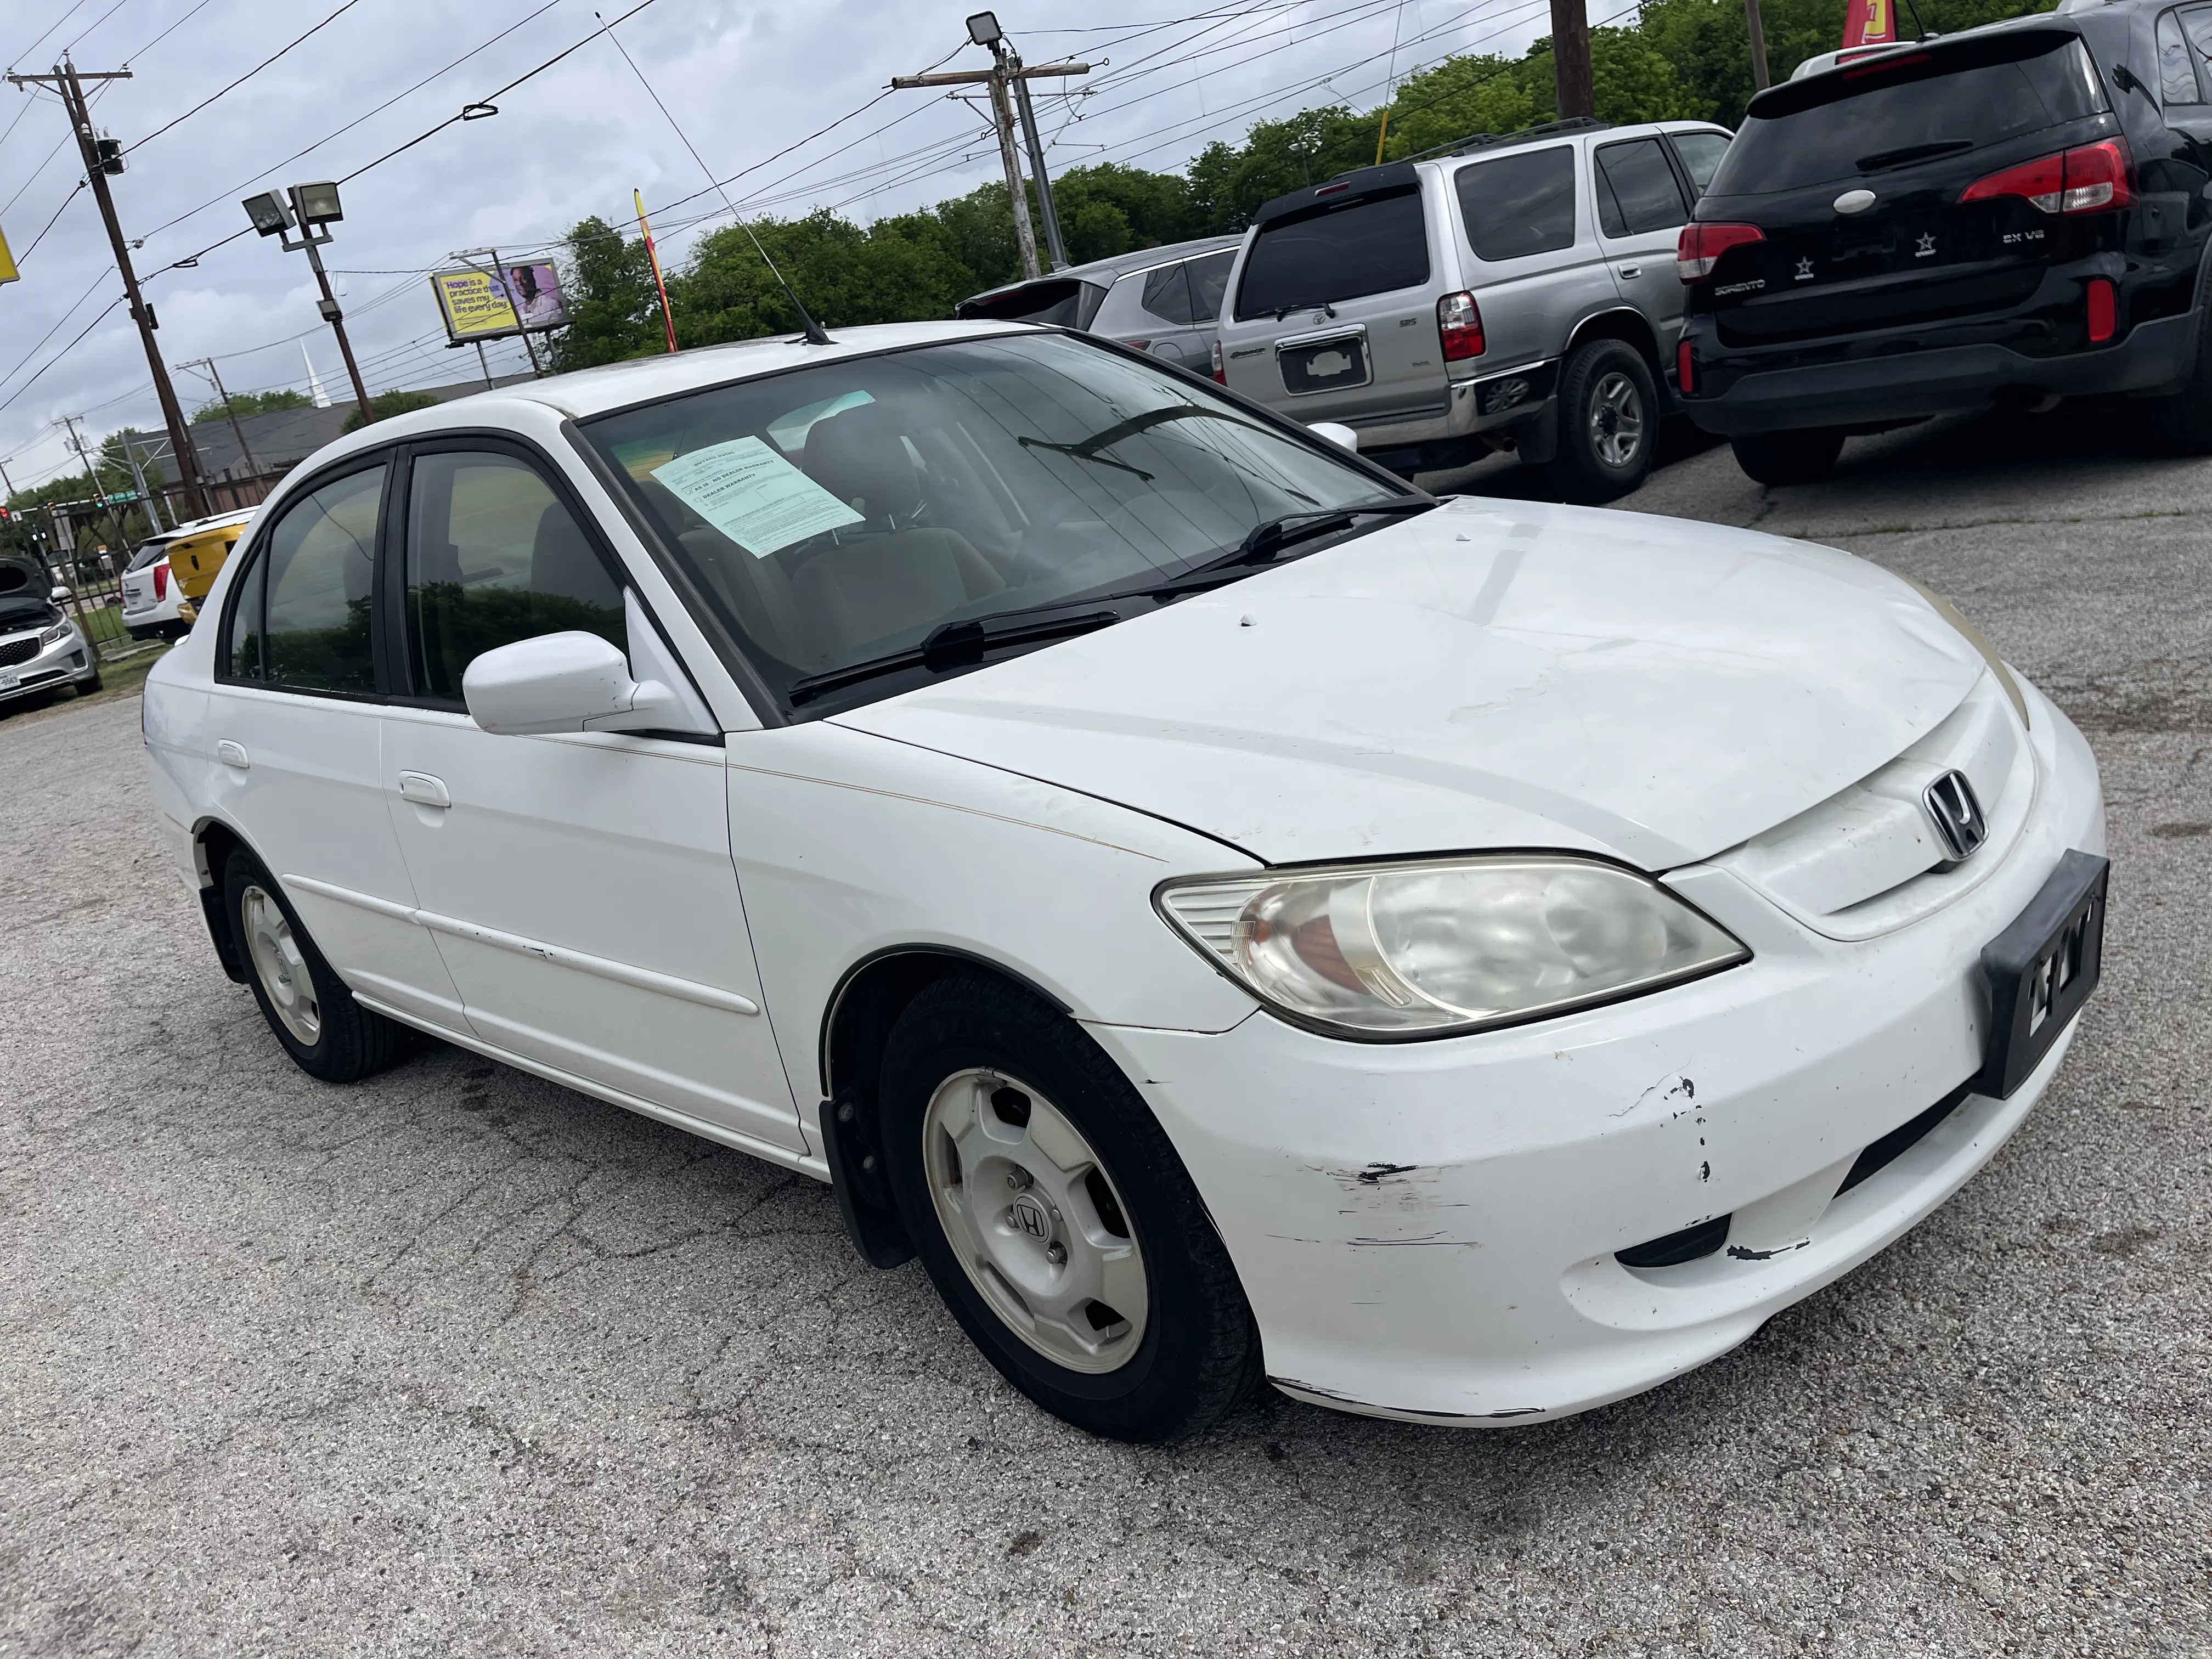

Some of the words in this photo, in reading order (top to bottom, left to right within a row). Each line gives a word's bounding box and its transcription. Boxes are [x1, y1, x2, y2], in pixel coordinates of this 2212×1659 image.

[2003, 233, 2022, 243] EX
[468, 278, 476, 286] is
[449, 286, 483, 298] practice
[483, 284, 501, 293] that
[452, 297, 476, 306] saves
[476, 295, 489, 303] my
[454, 306, 467, 314] life
[468, 303, 491, 312] every
[721, 468, 743, 478] DEALER
[743, 460, 774, 470] WARRANTY
[702, 487, 725, 499] DEALER
[725, 473, 756, 488] WARRANTY
